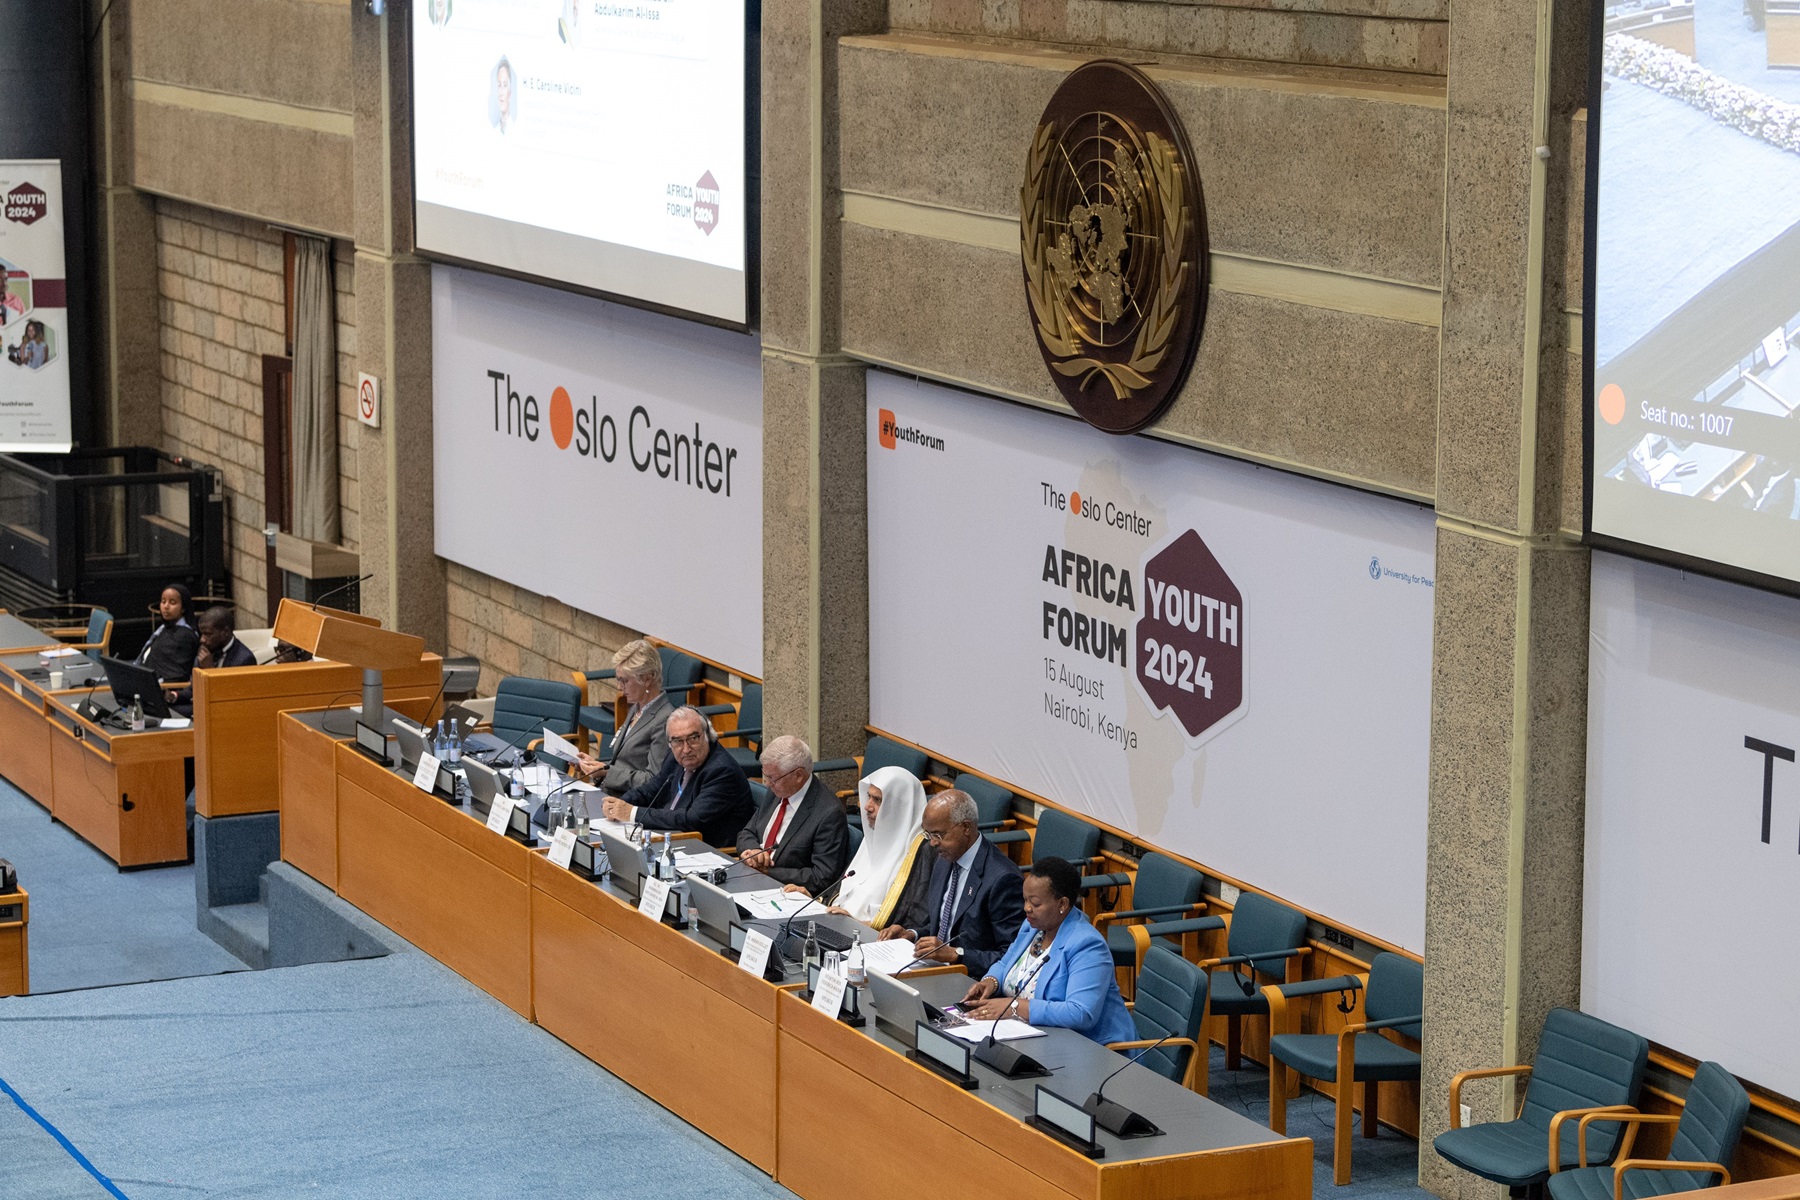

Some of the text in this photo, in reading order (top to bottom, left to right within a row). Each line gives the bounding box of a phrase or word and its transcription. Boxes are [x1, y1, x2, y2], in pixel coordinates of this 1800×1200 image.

[595, 3, 660, 21] Abdulkarim Al-Issa
[536, 78, 563, 94] Caroline
[563, 81, 582, 97] Vicini
[8, 206, 36, 218] 2024
[9, 194, 46, 205] YOUTH
[667, 183, 720, 206] AFRICA YOUTH
[667, 202, 714, 224] FORUM 2024
[487, 369, 540, 442] The
[629, 405, 738, 498] Center
[883, 420, 945, 452] #YouthForum
[1640, 400, 1734, 437] Seat no.: 1007
[1041, 481, 1066, 511] The
[1105, 501, 1152, 538] Center
[1042, 545, 1136, 612] AFRICA
[1384, 568, 1411, 584] University
[1412, 574, 1421, 584] for
[1147, 577, 1238, 647] YOUTH
[1043, 600, 1127, 668] FORUM
[1044, 657, 1105, 700] 15 August
[1144, 637, 1213, 700] 2024
[1044, 692, 1138, 750] Nairobi, Kenya
[1744, 735, 1800, 855] T
